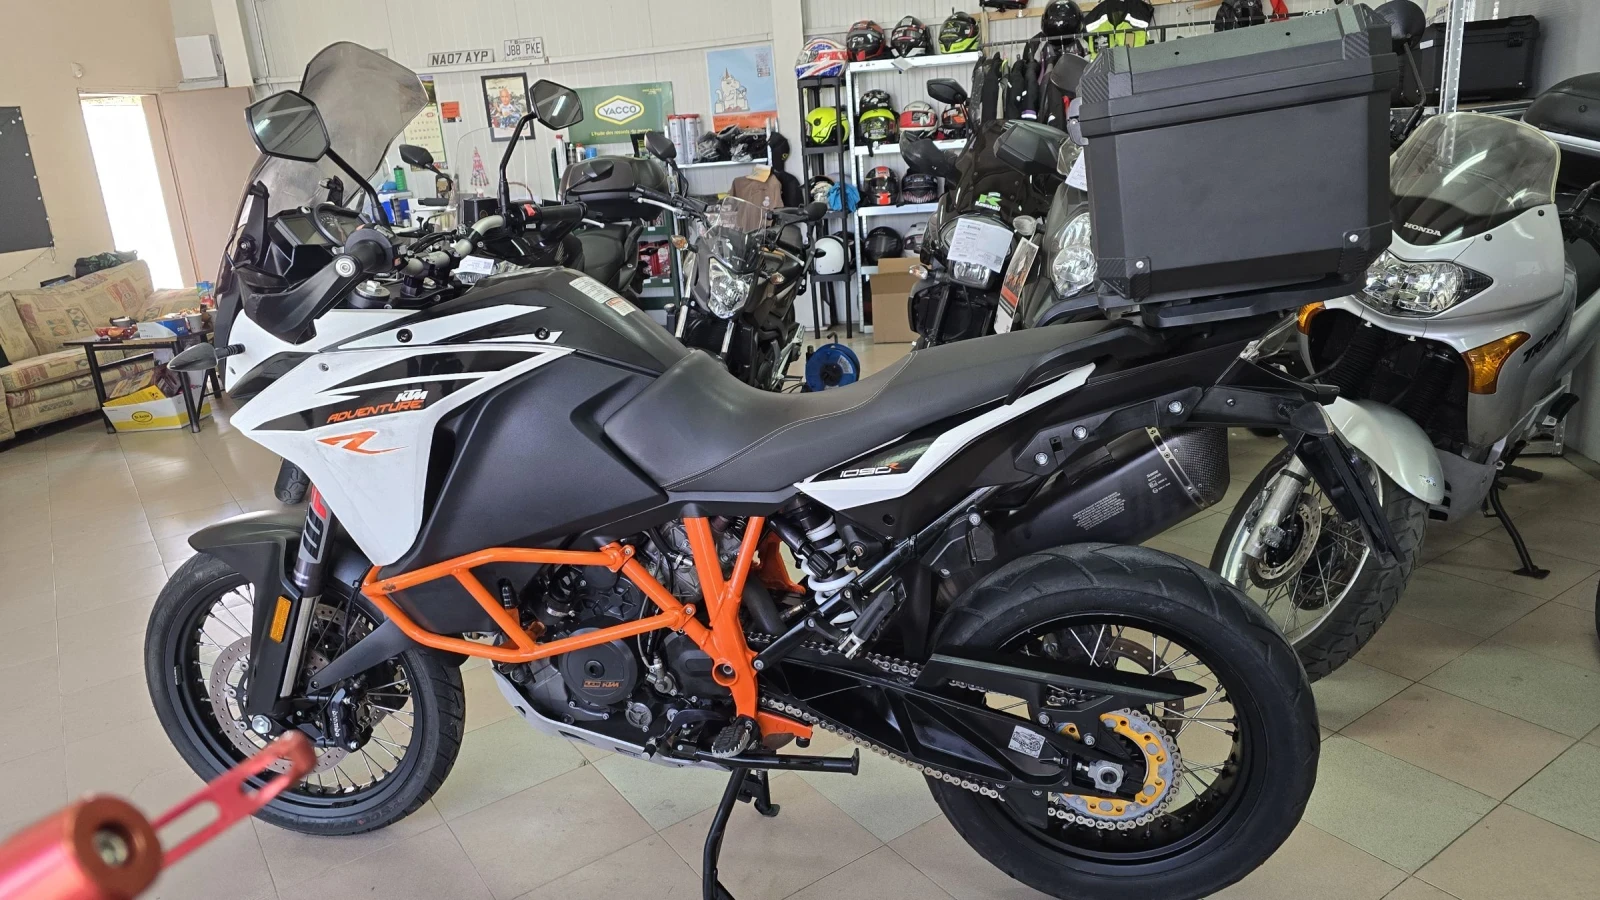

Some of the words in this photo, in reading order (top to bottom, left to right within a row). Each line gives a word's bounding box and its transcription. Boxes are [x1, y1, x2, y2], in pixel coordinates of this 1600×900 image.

[506, 45, 521, 57] J88
[525, 42, 542, 55] PKE
[431, 53, 462, 66] NA07
[465, 51, 489, 63] AYP
[602, 106, 637, 115] YACCO
[975, 200, 1001, 212] Kawasaki
[1403, 222, 1442, 237] HONDA
[394, 389, 429, 403] KTM
[326, 400, 425, 424] ADVENTURE
[315, 430, 410, 455] R
[840, 466, 892, 478] 1090
